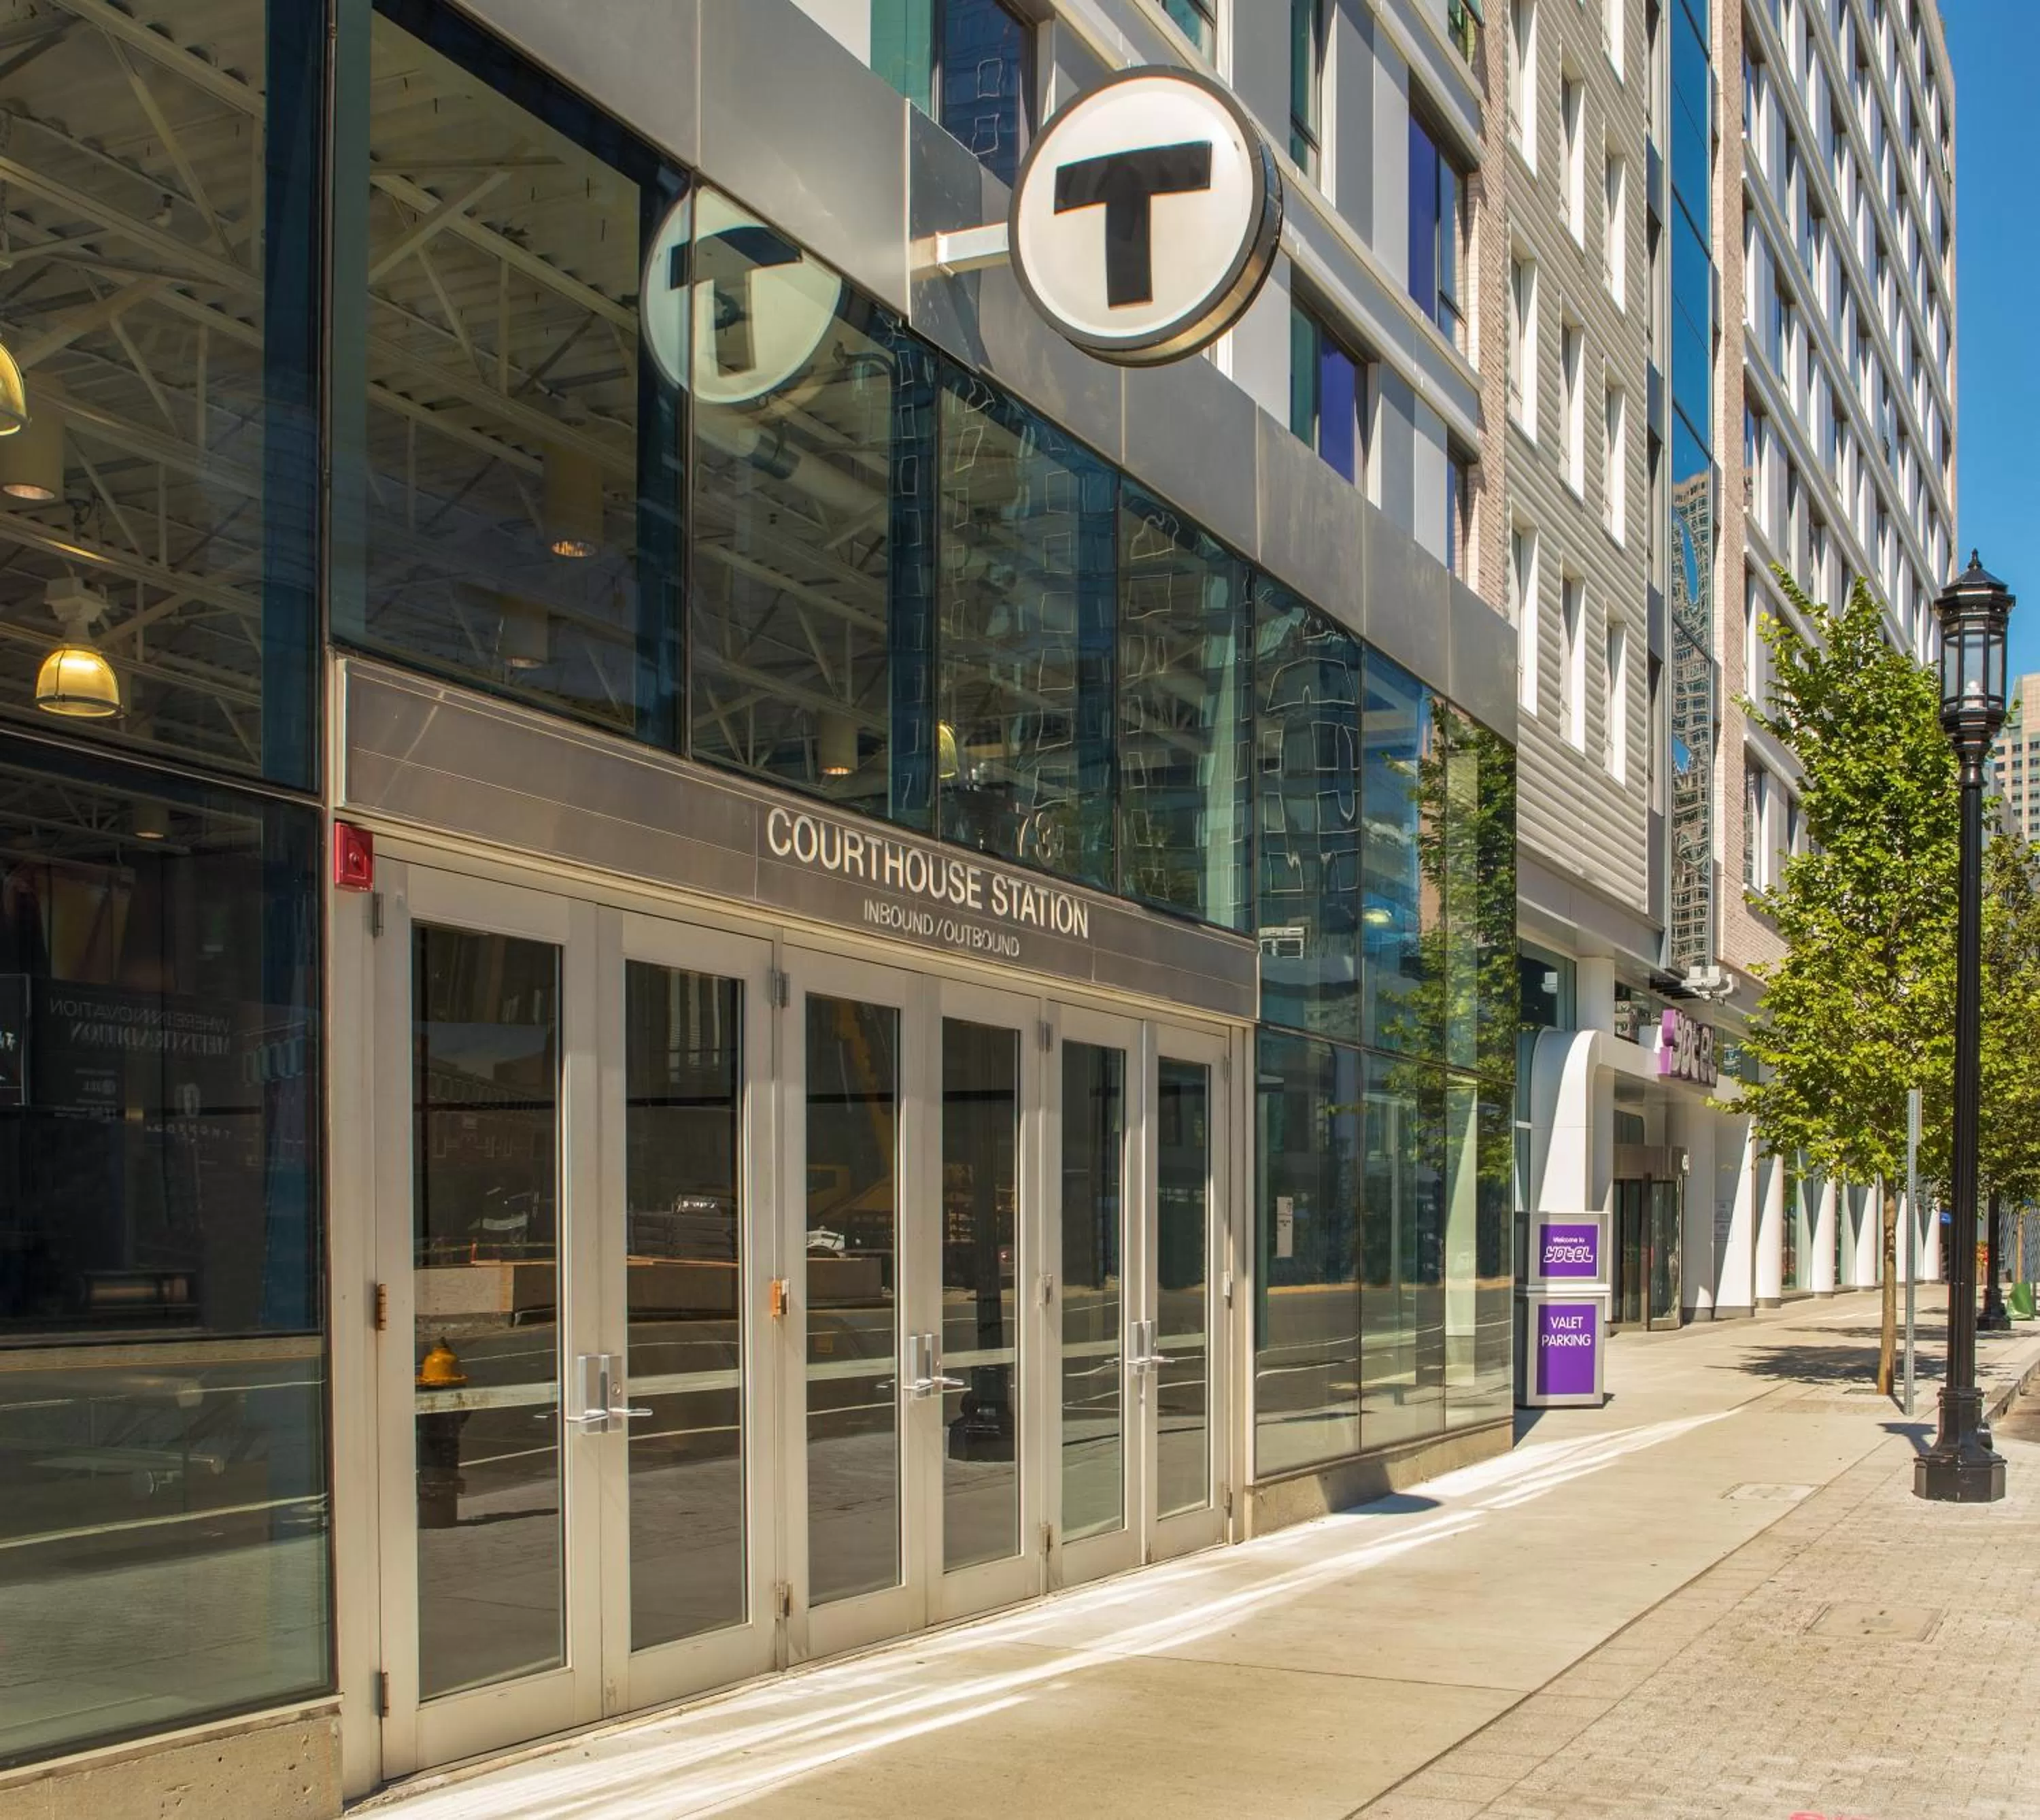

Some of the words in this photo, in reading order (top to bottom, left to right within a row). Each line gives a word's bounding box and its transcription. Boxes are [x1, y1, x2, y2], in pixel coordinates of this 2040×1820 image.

[1054, 140, 1212, 310] T
[766, 807, 983, 909] COURTHOUSE
[991, 873, 1089, 939] STATION
[1542, 1334, 1591, 1347] PARKING
[1550, 1316, 1584, 1329] VALET
